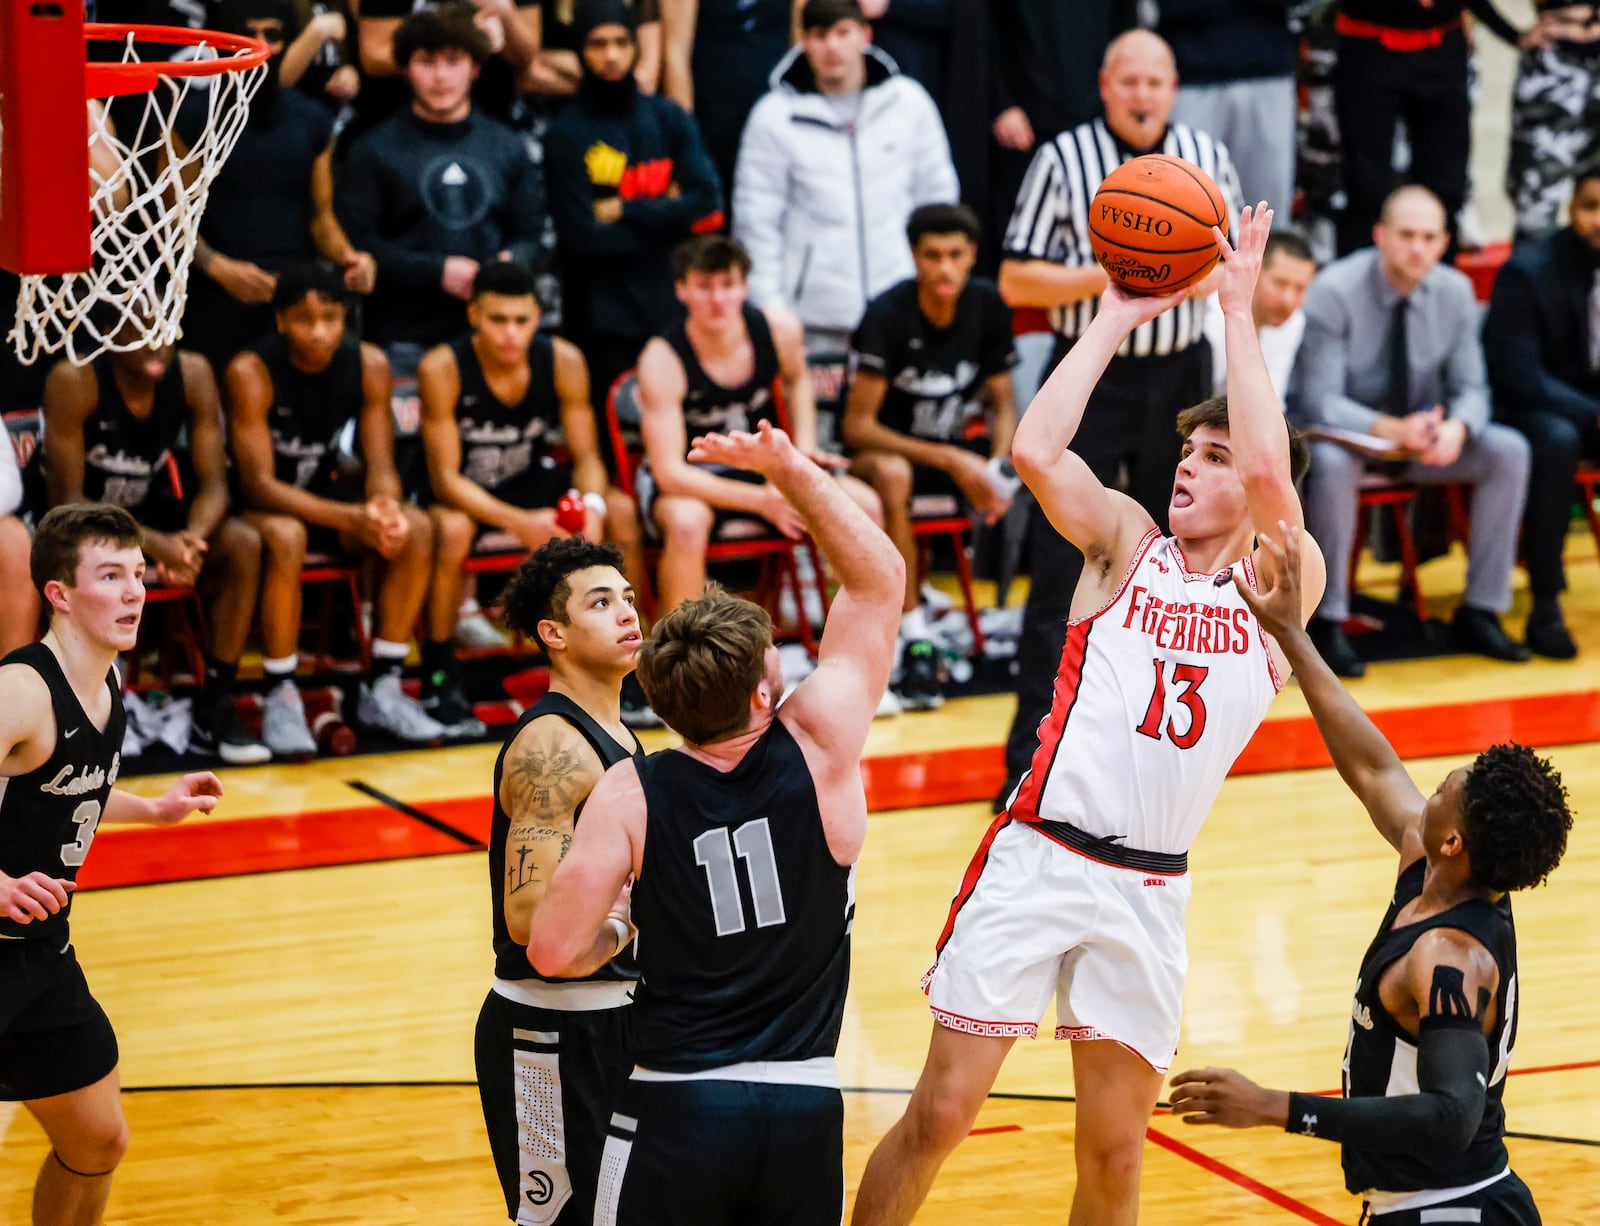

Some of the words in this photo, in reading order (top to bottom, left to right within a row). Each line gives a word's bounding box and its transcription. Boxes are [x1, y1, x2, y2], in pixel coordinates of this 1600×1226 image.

[1102, 204, 1173, 237] OHSAA
[1136, 658, 1209, 750] 13
[60, 800, 101, 866] 3
[693, 817, 786, 936] 11
